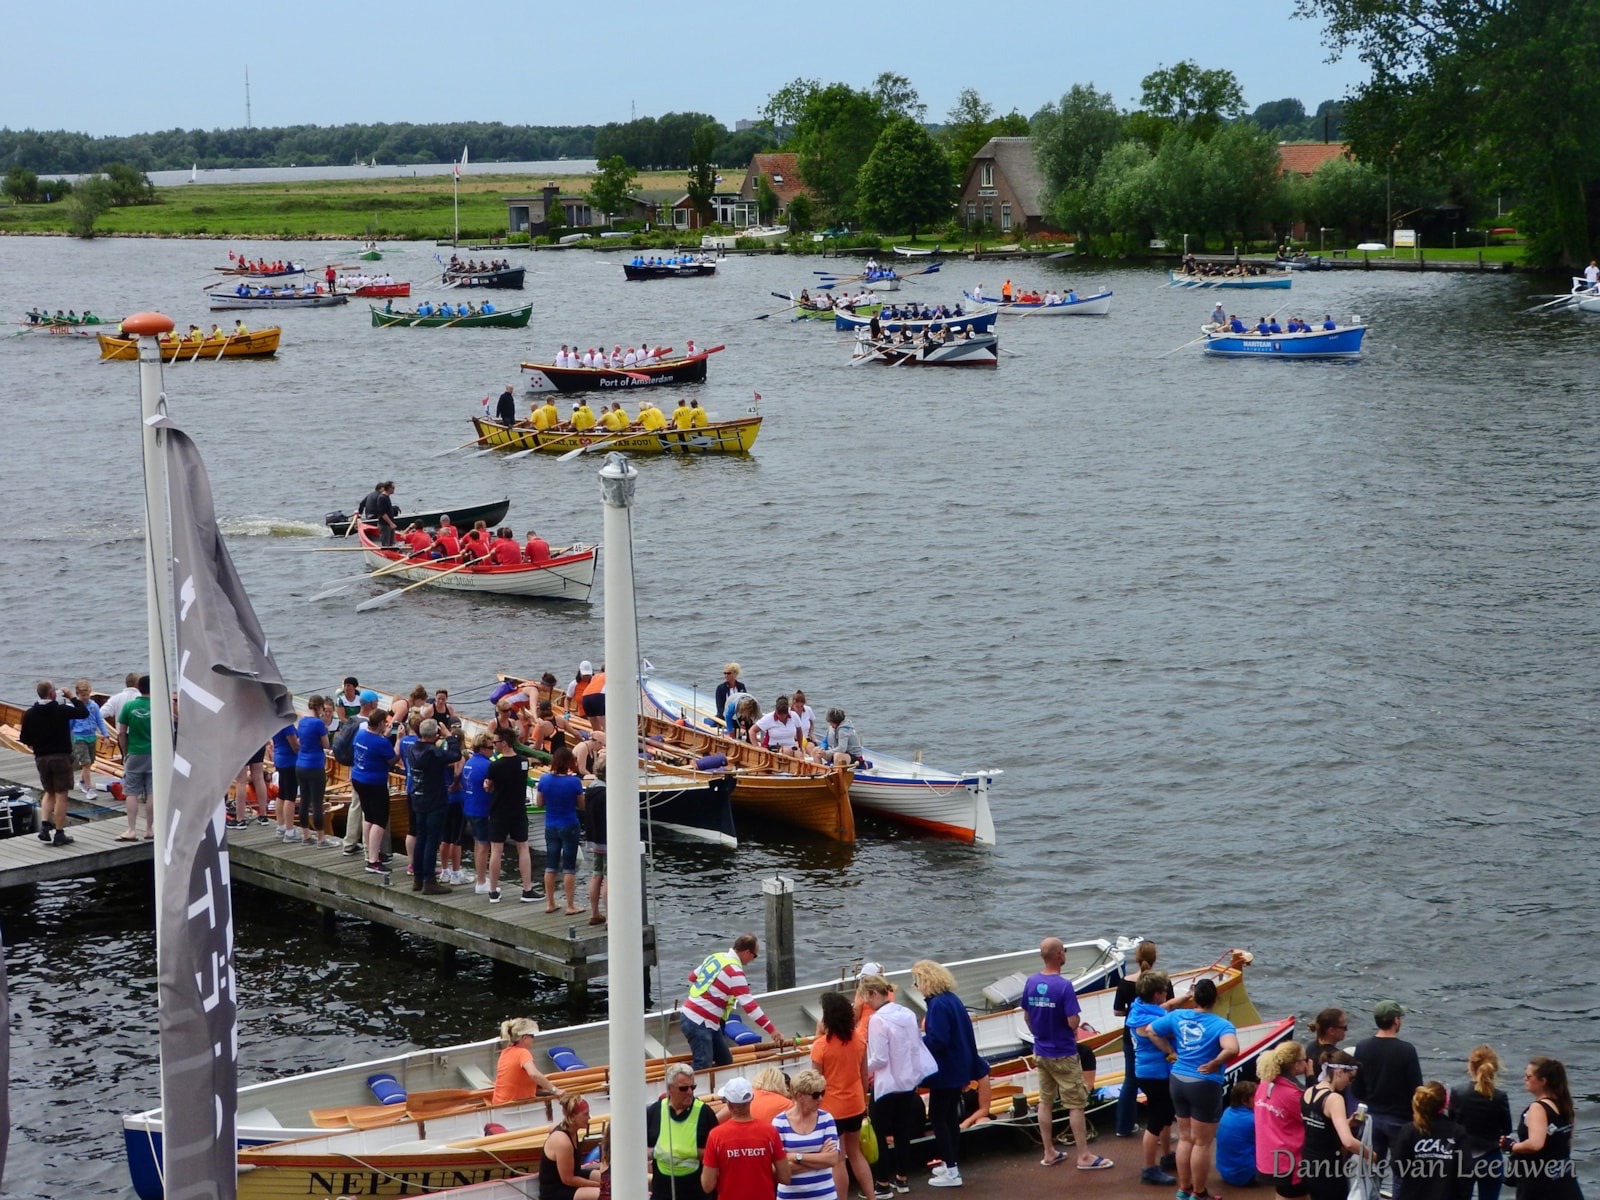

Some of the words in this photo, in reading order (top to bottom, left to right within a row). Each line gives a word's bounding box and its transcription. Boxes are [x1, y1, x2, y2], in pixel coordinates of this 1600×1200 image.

[50, 326, 72, 334] STIHL
[600, 378, 617, 387] Port
[620, 377, 629, 386] of
[631, 374, 673, 386] Amsterdam
[1414, 1138, 1441, 1152] CCA
[726, 1149, 740, 1158] DE
[741, 1147, 766, 1157] VEGT
